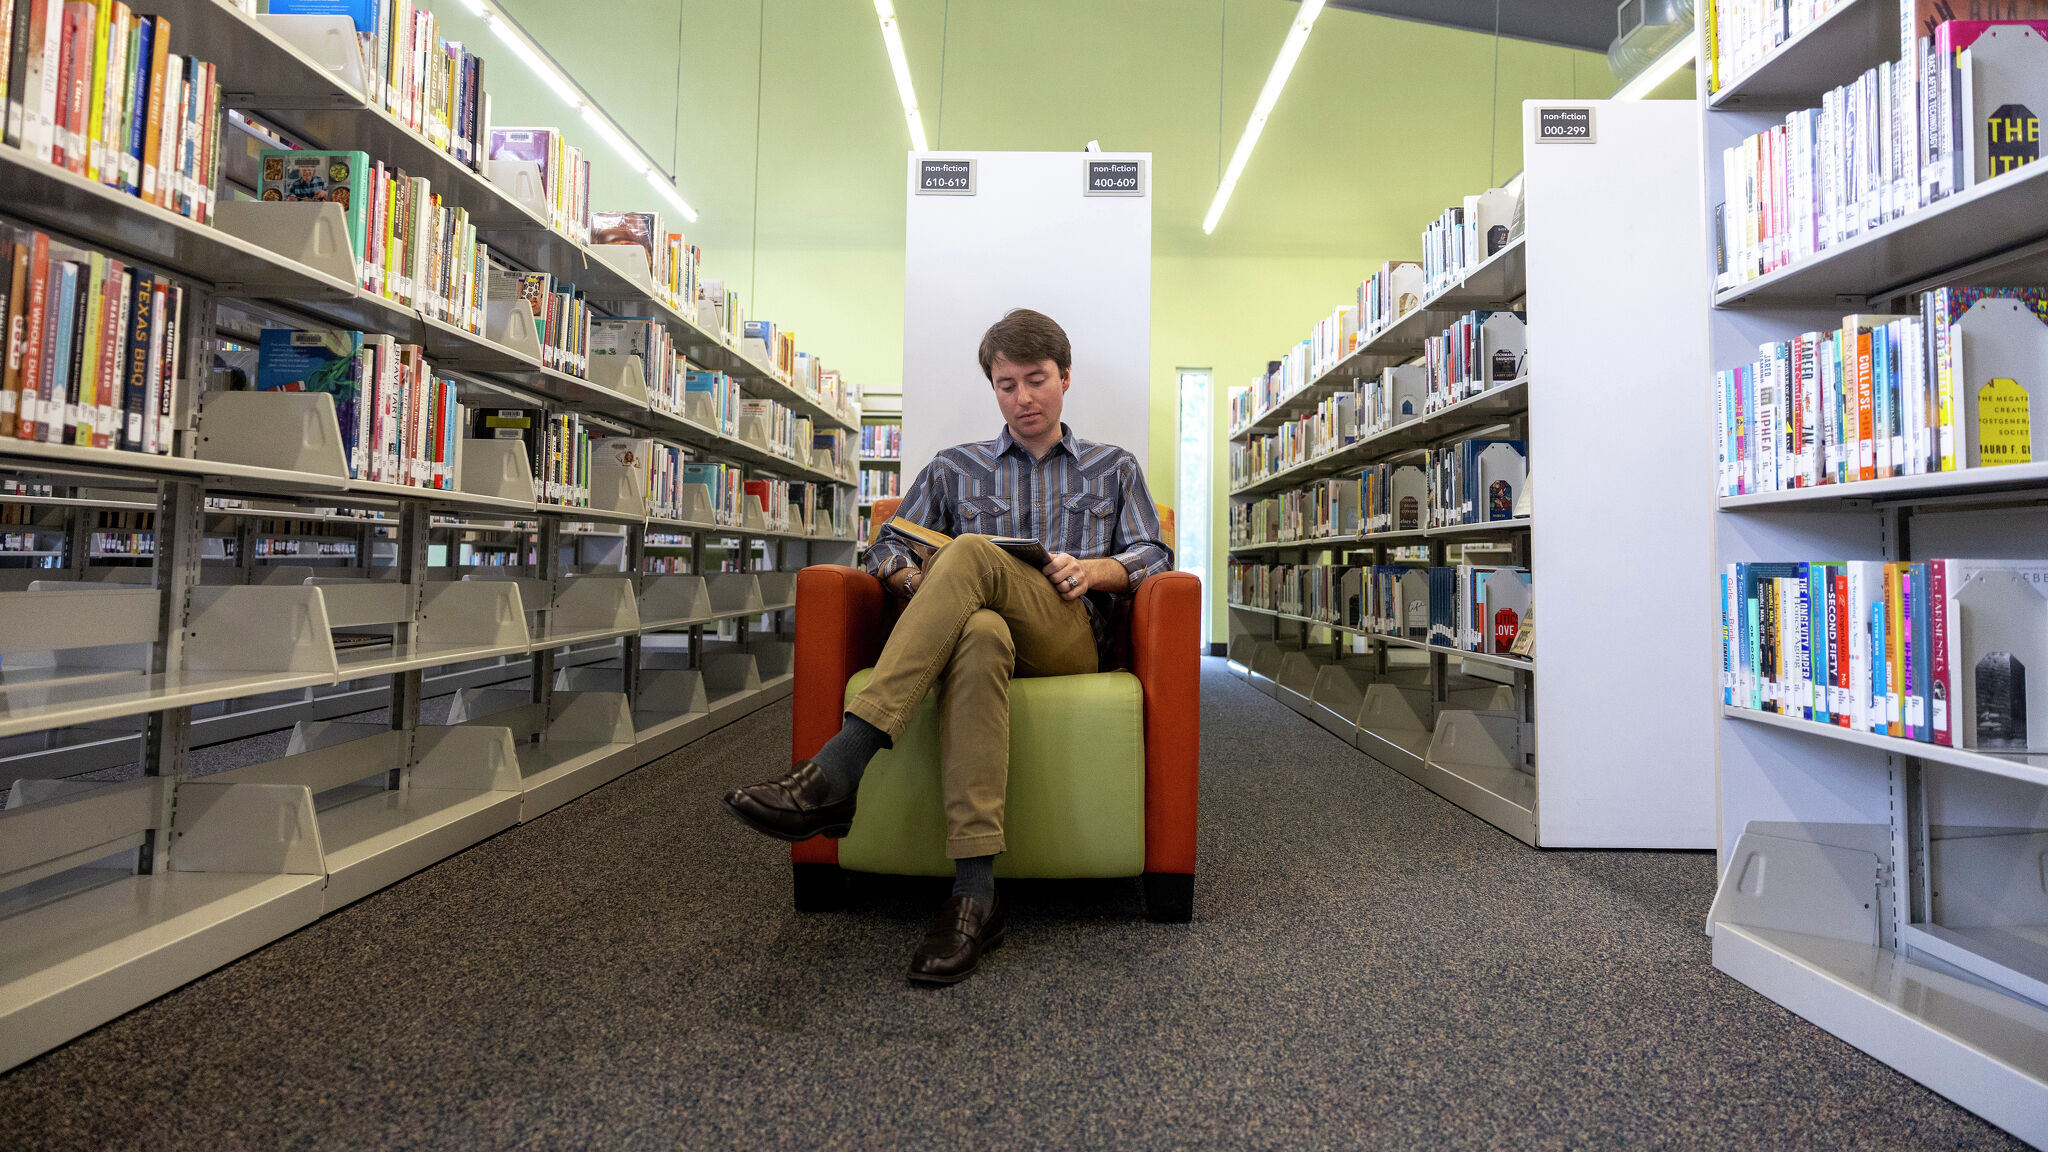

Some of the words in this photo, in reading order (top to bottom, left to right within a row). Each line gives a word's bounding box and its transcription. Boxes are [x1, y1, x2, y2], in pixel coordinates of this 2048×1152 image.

[1928, 54, 1936, 76] RACE
[154, 73, 162, 92] MILK
[1929, 78, 1937, 98] AFTER
[151, 96, 160, 126] STREET
[1543, 112, 1587, 120] non-fiction
[1929, 98, 1938, 151] TECHNOLOGY
[1544, 126, 1586, 135] 000-299
[1988, 118, 2039, 143] THE
[925, 164, 968, 173] non-fiction
[925, 178, 967, 187] 610-619
[1093, 164, 1137, 173] non-fiction
[1094, 178, 1136, 188] 400-609
[409, 185, 417, 241] HOMEMADE
[33, 278, 44, 303] THE
[1935, 294, 1944, 317] THE
[108, 299, 117, 335] PRAISE
[136, 280, 152, 342] TEXAS
[29, 308, 41, 355] WHOLE
[106, 339, 114, 357] THE
[165, 321, 174, 376] GUERRILLA
[1802, 340, 1814, 379] FAREED
[1936, 324, 1948, 403] PERENNIALS
[25, 358, 37, 389] DUC
[131, 348, 146, 386] BBQ
[1846, 344, 1854, 403] NATURE'S
[162, 379, 170, 413] TACOS
[391, 350, 400, 420] BRAVETART
[1859, 355, 1870, 411] COLLAPSE
[1761, 410, 1771, 452] UPHEA
[2011, 445, 2018, 454] F.
[1799, 578, 1807, 593] THE
[1793, 596, 1801, 633] Honest
[1800, 597, 1809, 647] LONGEVITY
[1828, 592, 1836, 641] SECOND
[1496, 625, 1515, 636] OVE
[1750, 625, 1754, 638] OK
[1934, 595, 1944, 672] PARISIENNES
[1794, 637, 1802, 669] Aging
[1801, 651, 1809, 681] IMPER
[1829, 643, 1837, 676] FIFTY
[1841, 673, 1846, 685] Mo
